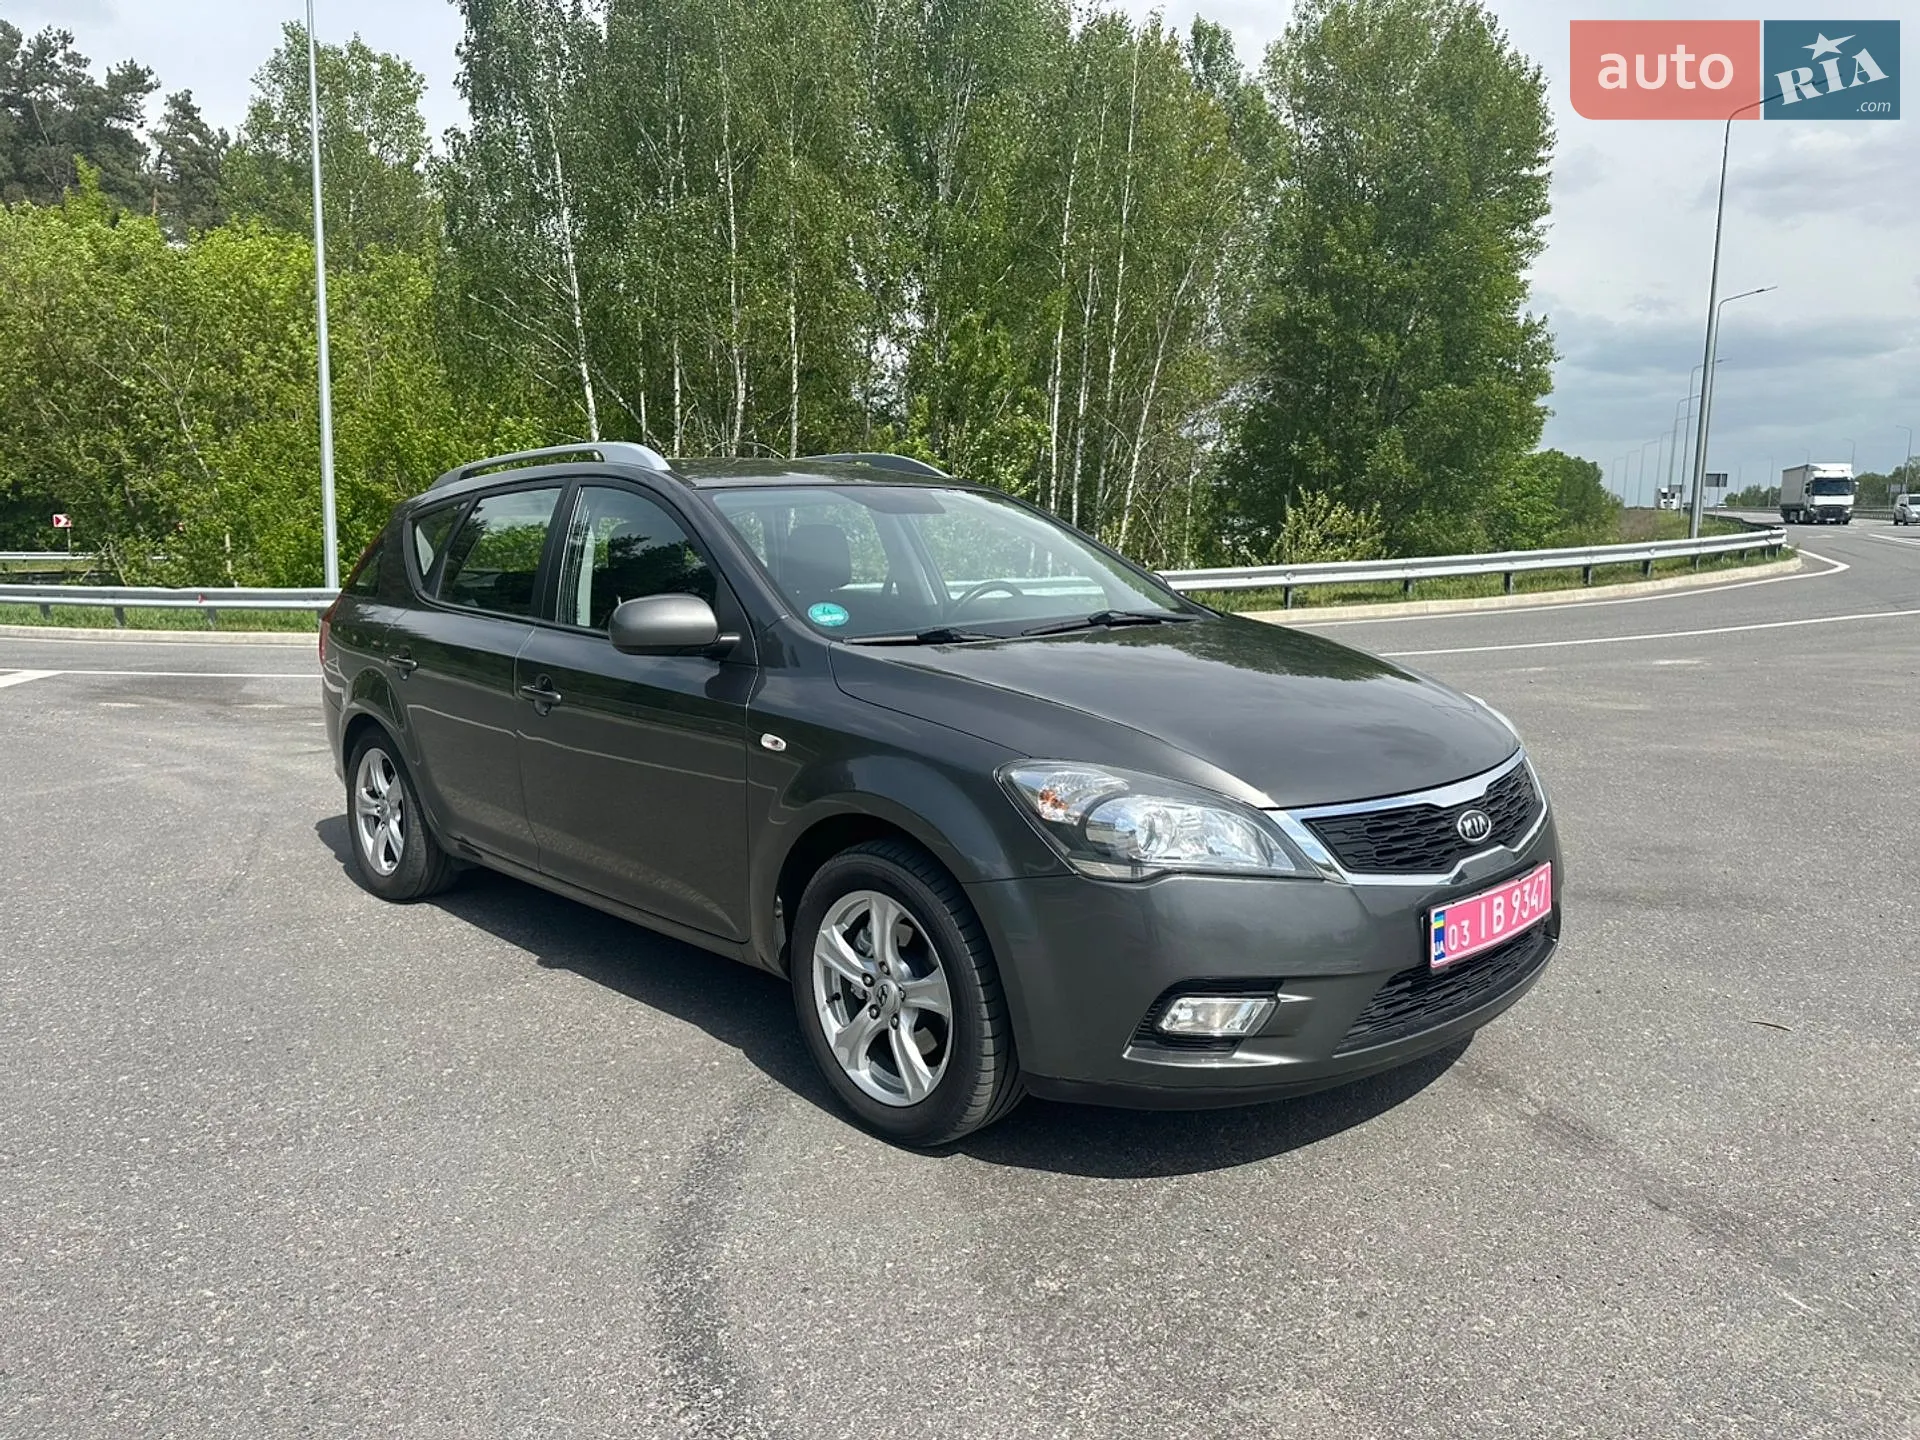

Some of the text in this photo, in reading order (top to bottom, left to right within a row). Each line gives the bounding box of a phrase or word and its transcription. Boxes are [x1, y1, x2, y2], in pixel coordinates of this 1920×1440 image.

[1462, 815, 1488, 837] KIA
[1448, 873, 1547, 951] 03 IB 9347
